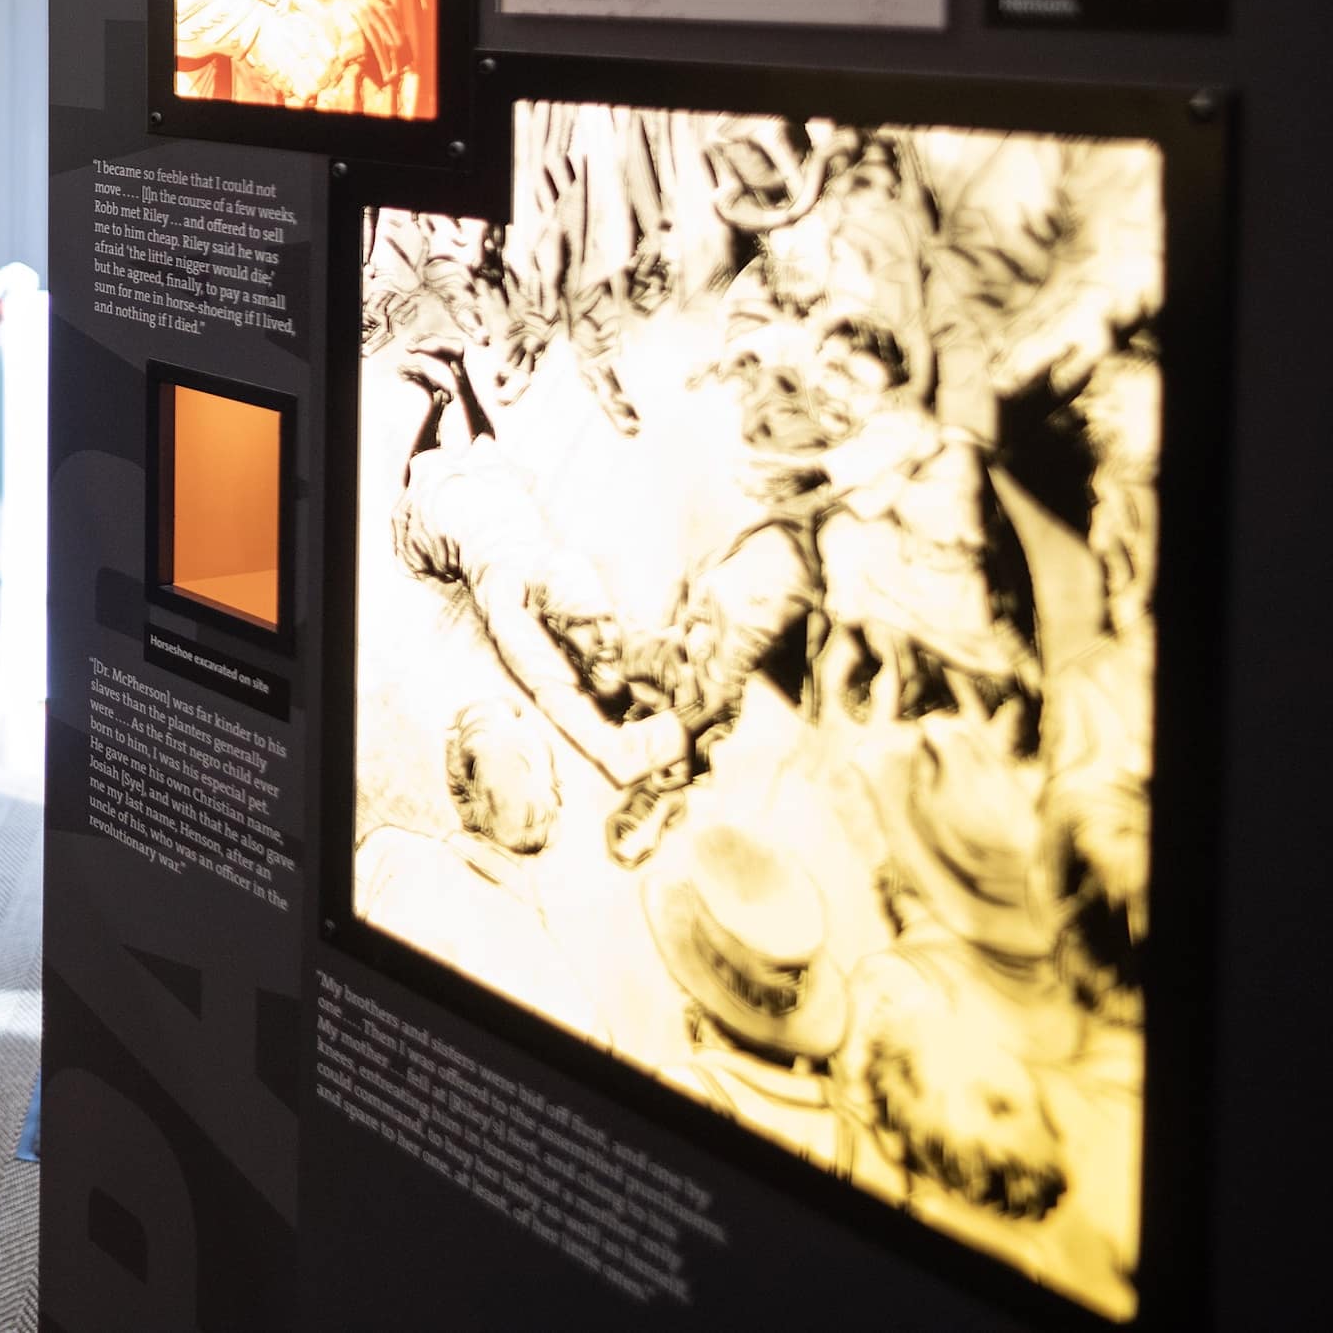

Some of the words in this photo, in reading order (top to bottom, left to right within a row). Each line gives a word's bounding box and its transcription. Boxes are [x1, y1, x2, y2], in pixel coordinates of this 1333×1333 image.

[103, 161, 141, 179] became
[143, 170, 154, 181] so
[157, 168, 188, 186] feeble
[191, 173, 214, 188] that
[216, 176, 220, 187] I
[222, 178, 253, 195] could
[256, 183, 276, 198] not
[94, 200, 118, 215] Robb
[121, 204, 140, 218] met
[142, 206, 169, 227] Riley
[184, 216, 204, 231] and
[206, 218, 246, 236] offered
[249, 225, 259, 238] to
[263, 227, 284, 243] sell
[95, 182, 121, 196] move
[159, 189, 176, 204] the
[178, 193, 212, 210] course
[213, 197, 225, 212] of
[226, 203, 233, 213] a
[235, 200, 255, 216] few
[258, 203, 297, 225] weeks,
[94, 221, 110, 234] me
[112, 223, 122, 236] to
[124, 225, 145, 241] him
[148, 229, 180, 249] cheap.
[183, 235, 210, 256] Riley
[212, 240, 234, 256] said
[237, 244, 252, 260] he
[254, 249, 279, 264] was
[94, 240, 124, 257] afraid
[148, 248, 173, 266] little
[176, 255, 211, 275] nigger
[213, 260, 248, 280] would
[94, 258, 111, 275] but
[113, 262, 125, 277] he
[127, 267, 164, 286] agreed,
[206, 281, 216, 295] to
[219, 286, 240, 303] pay
[242, 290, 250, 302] a
[252, 292, 286, 310] small
[94, 281, 116, 295] sum
[118, 282, 132, 298] for
[134, 288, 150, 302] me
[153, 290, 164, 305] in
[166, 293, 243, 327] horse-shoeing
[245, 307, 254, 324] if
[256, 312, 261, 325] I
[263, 312, 296, 336] lived,
[94, 300, 113, 315] and
[115, 304, 156, 328] nothing
[158, 311, 167, 327] if
[168, 315, 173, 328] I
[150, 634, 194, 663] Horseshoe
[194, 651, 237, 680] excavated
[239, 672, 251, 685] on
[252, 676, 269, 695] site
[172, 695, 194, 717] was
[196, 705, 213, 724] far
[214, 713, 252, 743] kinder
[253, 728, 266, 749] to
[268, 736, 287, 759] his
